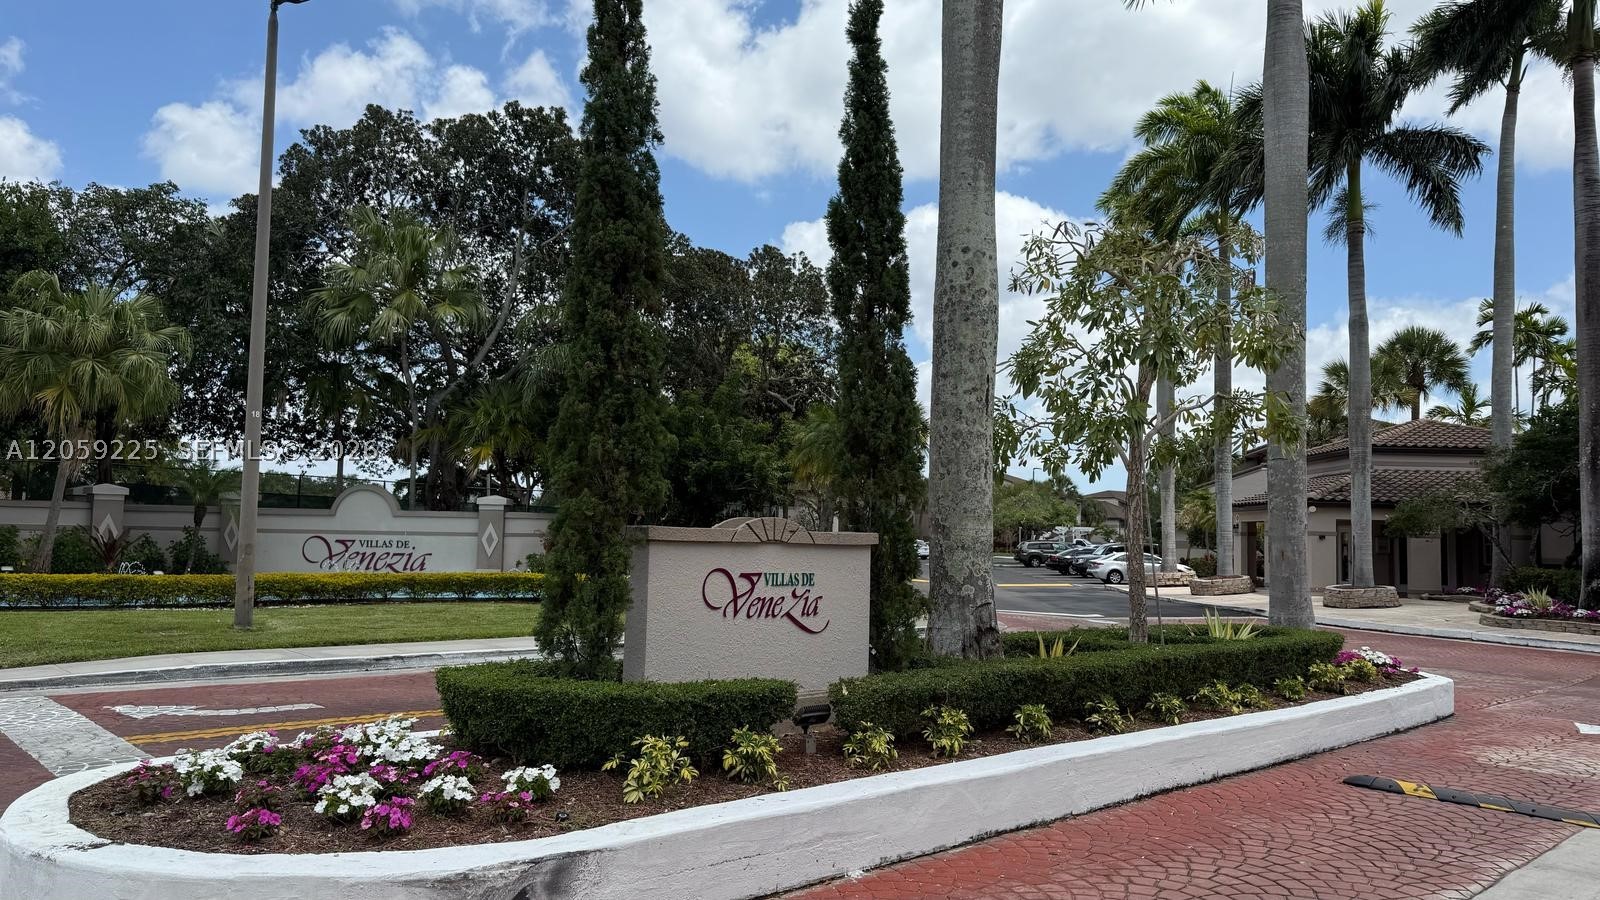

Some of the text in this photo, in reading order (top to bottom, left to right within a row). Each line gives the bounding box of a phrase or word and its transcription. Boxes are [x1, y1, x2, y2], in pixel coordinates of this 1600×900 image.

[251, 410, 260, 418] 18
[359, 540, 410, 549] VILLAS DE
[302, 535, 433, 573] Venezia
[764, 572, 815, 587] VILLAS DE
